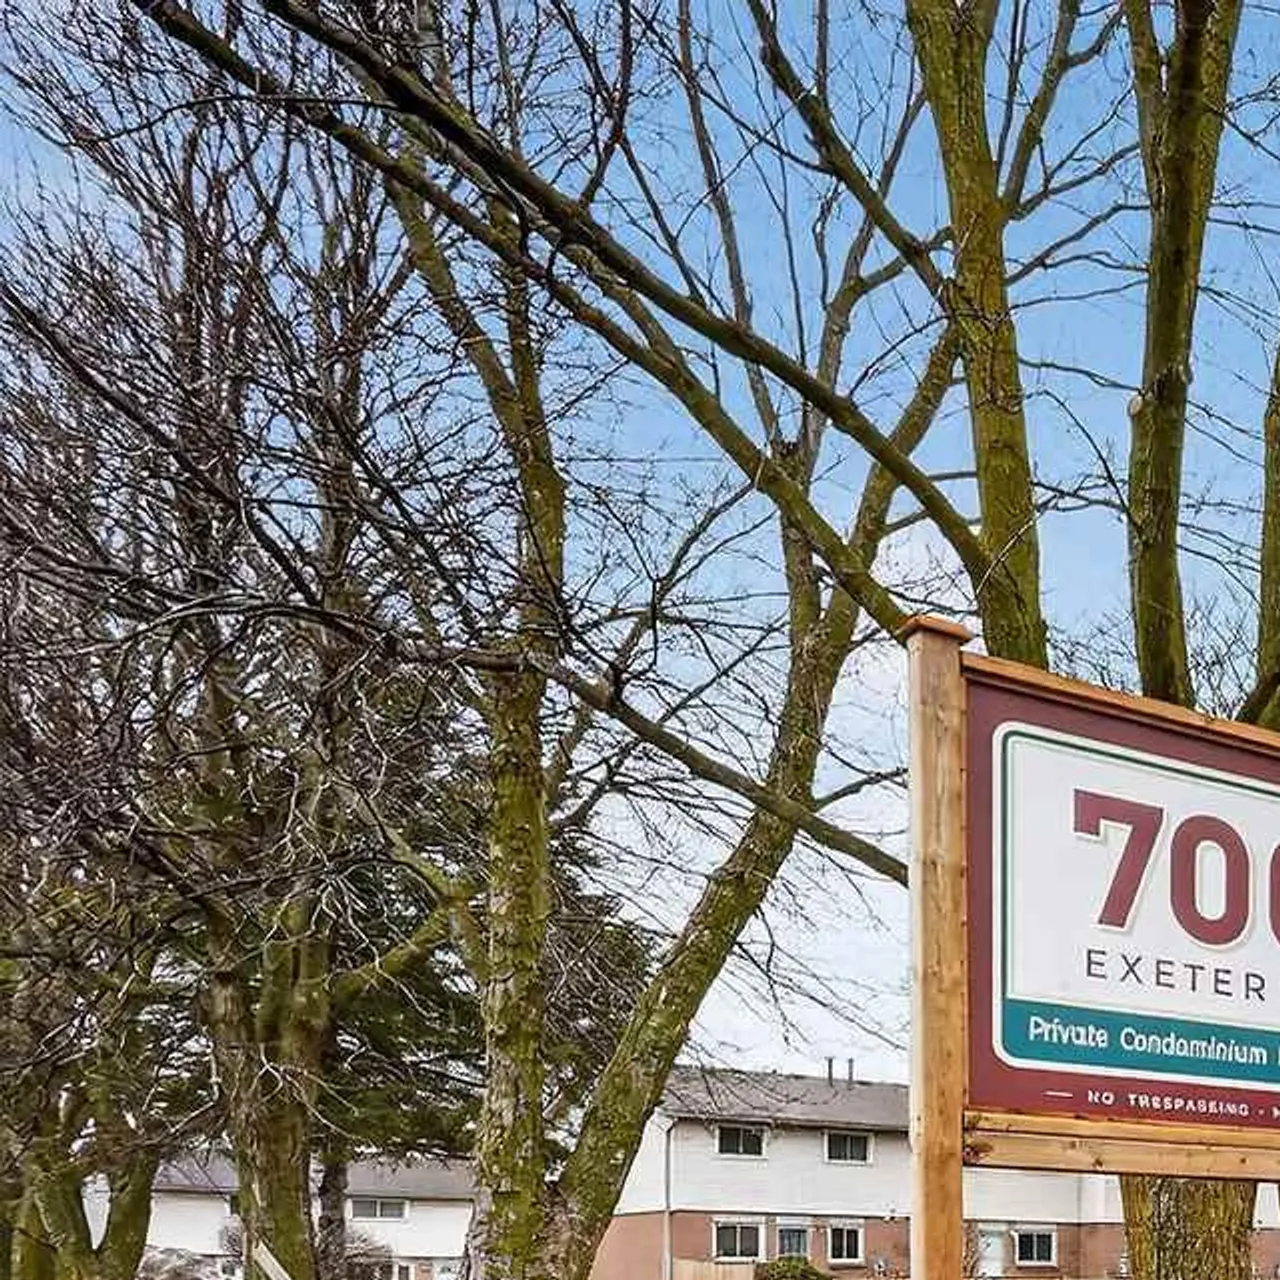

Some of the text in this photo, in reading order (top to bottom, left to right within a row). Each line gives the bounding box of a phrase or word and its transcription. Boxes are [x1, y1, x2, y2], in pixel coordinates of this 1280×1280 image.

[1085, 948, 1266, 1001] EXETER
[1027, 1015, 1109, 1048] Private
[1119, 1026, 1268, 1066] Condominium
[1087, 1089, 1115, 1106] NO
[1127, 1093, 1250, 1117] TRESPASSING
